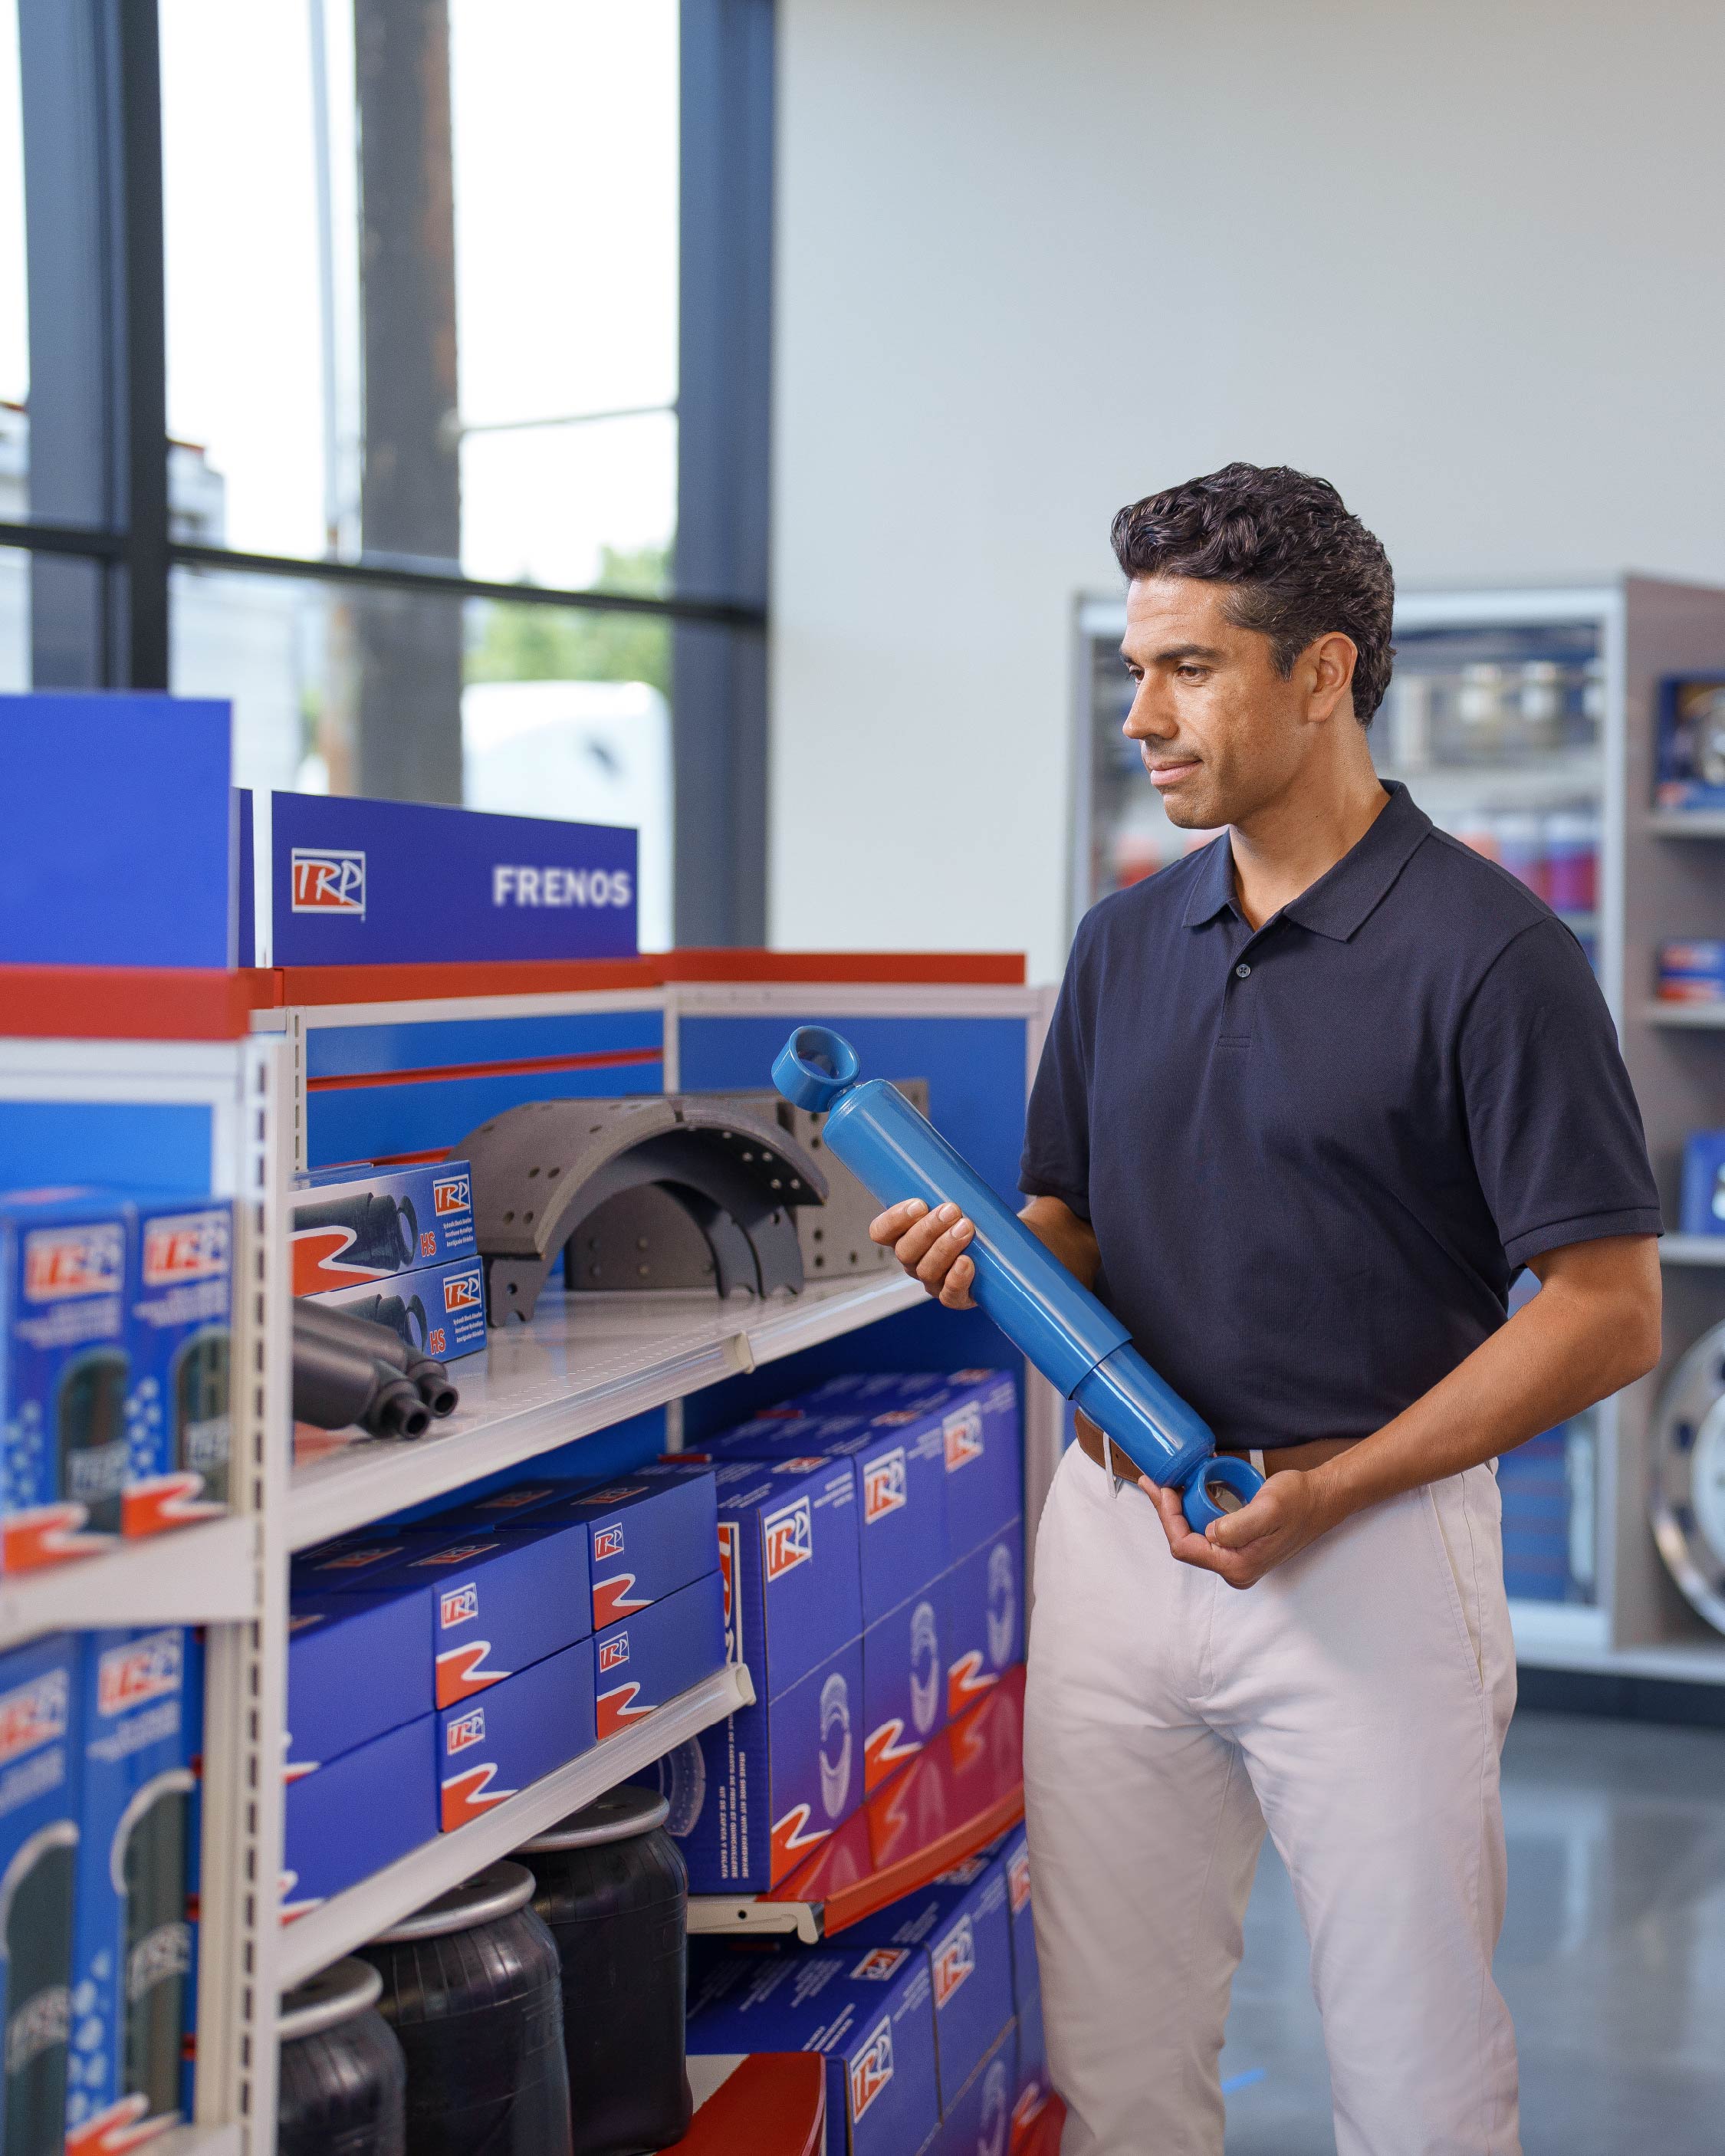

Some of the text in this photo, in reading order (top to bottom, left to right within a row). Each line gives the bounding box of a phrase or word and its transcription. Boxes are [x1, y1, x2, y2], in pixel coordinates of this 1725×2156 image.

[293, 857, 631, 908] TRP FRENOS
[434, 1181, 471, 1211] TRP
[420, 1231, 437, 1257] HS
[444, 1277, 481, 1306] TRP
[429, 1328, 446, 1356] HS
[595, 1529, 624, 1555] TRP
[766, 1510, 813, 1570] TRP
[442, 1590, 478, 1621] TRP
[600, 1638, 629, 1666] TRP
[447, 1715, 485, 1746] TRP
[850, 2033, 894, 2110] TRP
